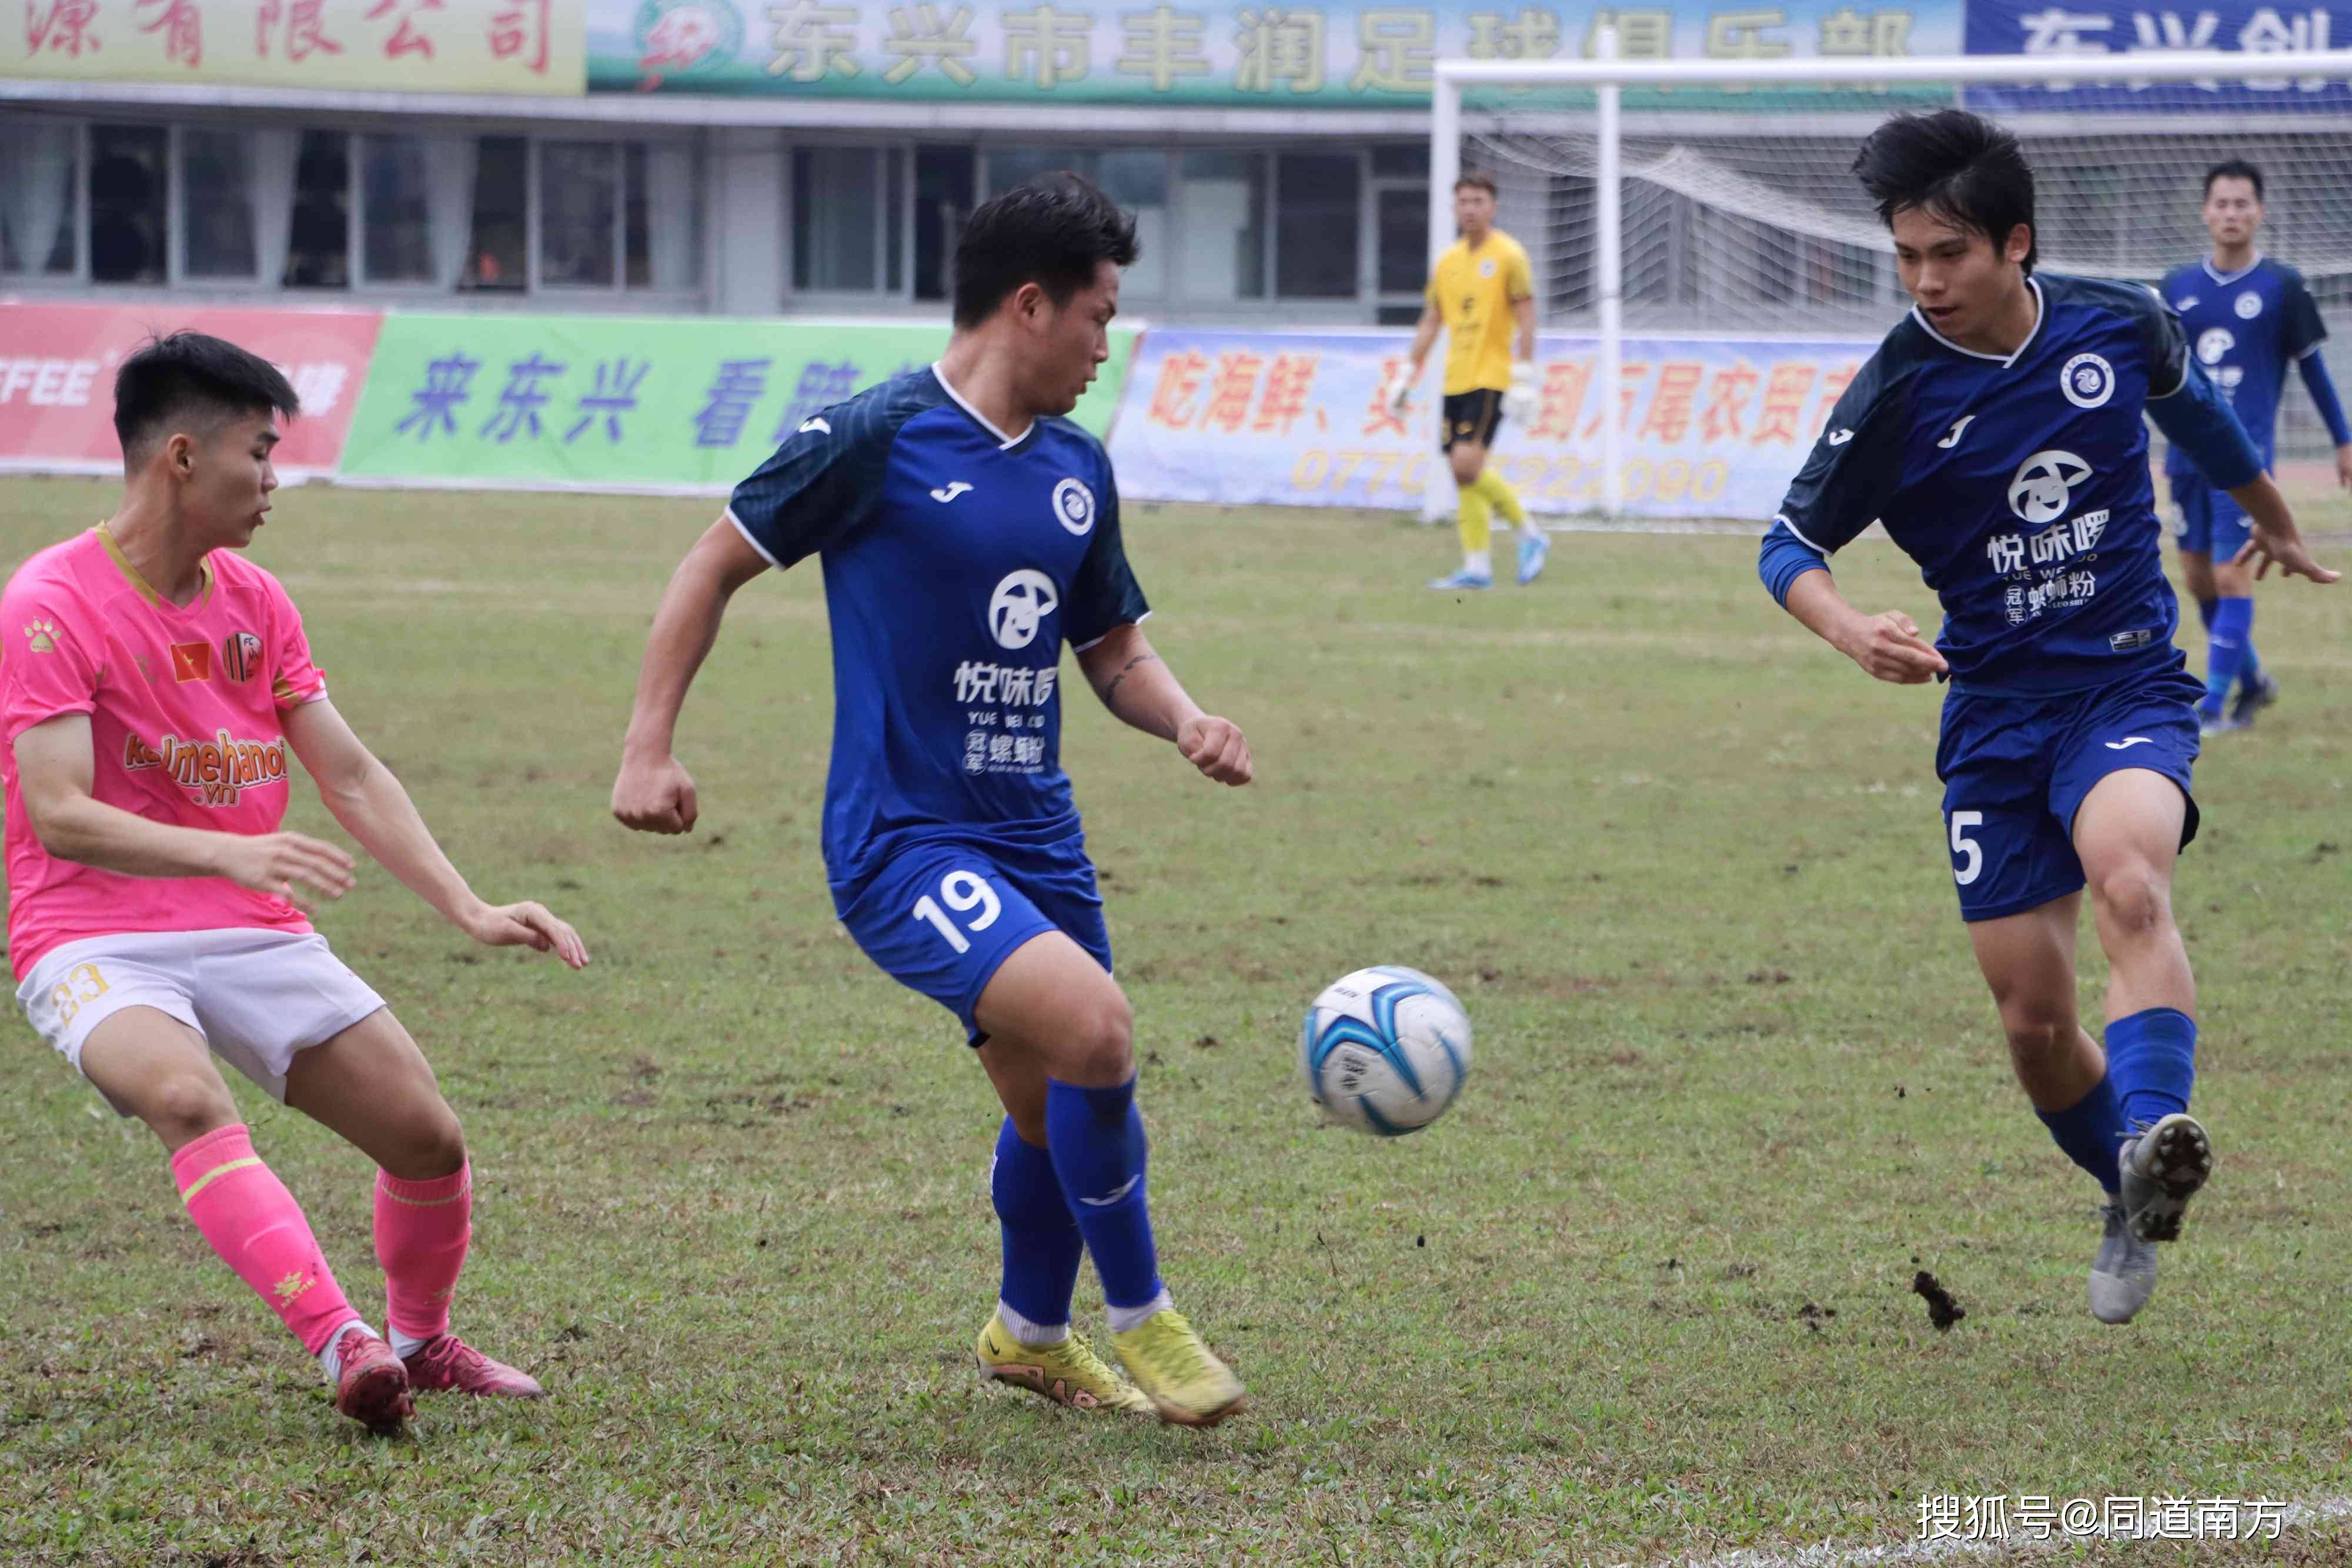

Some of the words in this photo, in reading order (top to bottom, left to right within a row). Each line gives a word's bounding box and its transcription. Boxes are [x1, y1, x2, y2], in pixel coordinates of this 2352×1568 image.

[395, 352, 650, 443] 来东兴
[968, 711, 998, 726] YUE
[1951, 811, 1983, 885] 5
[913, 870, 1002, 954] 19
